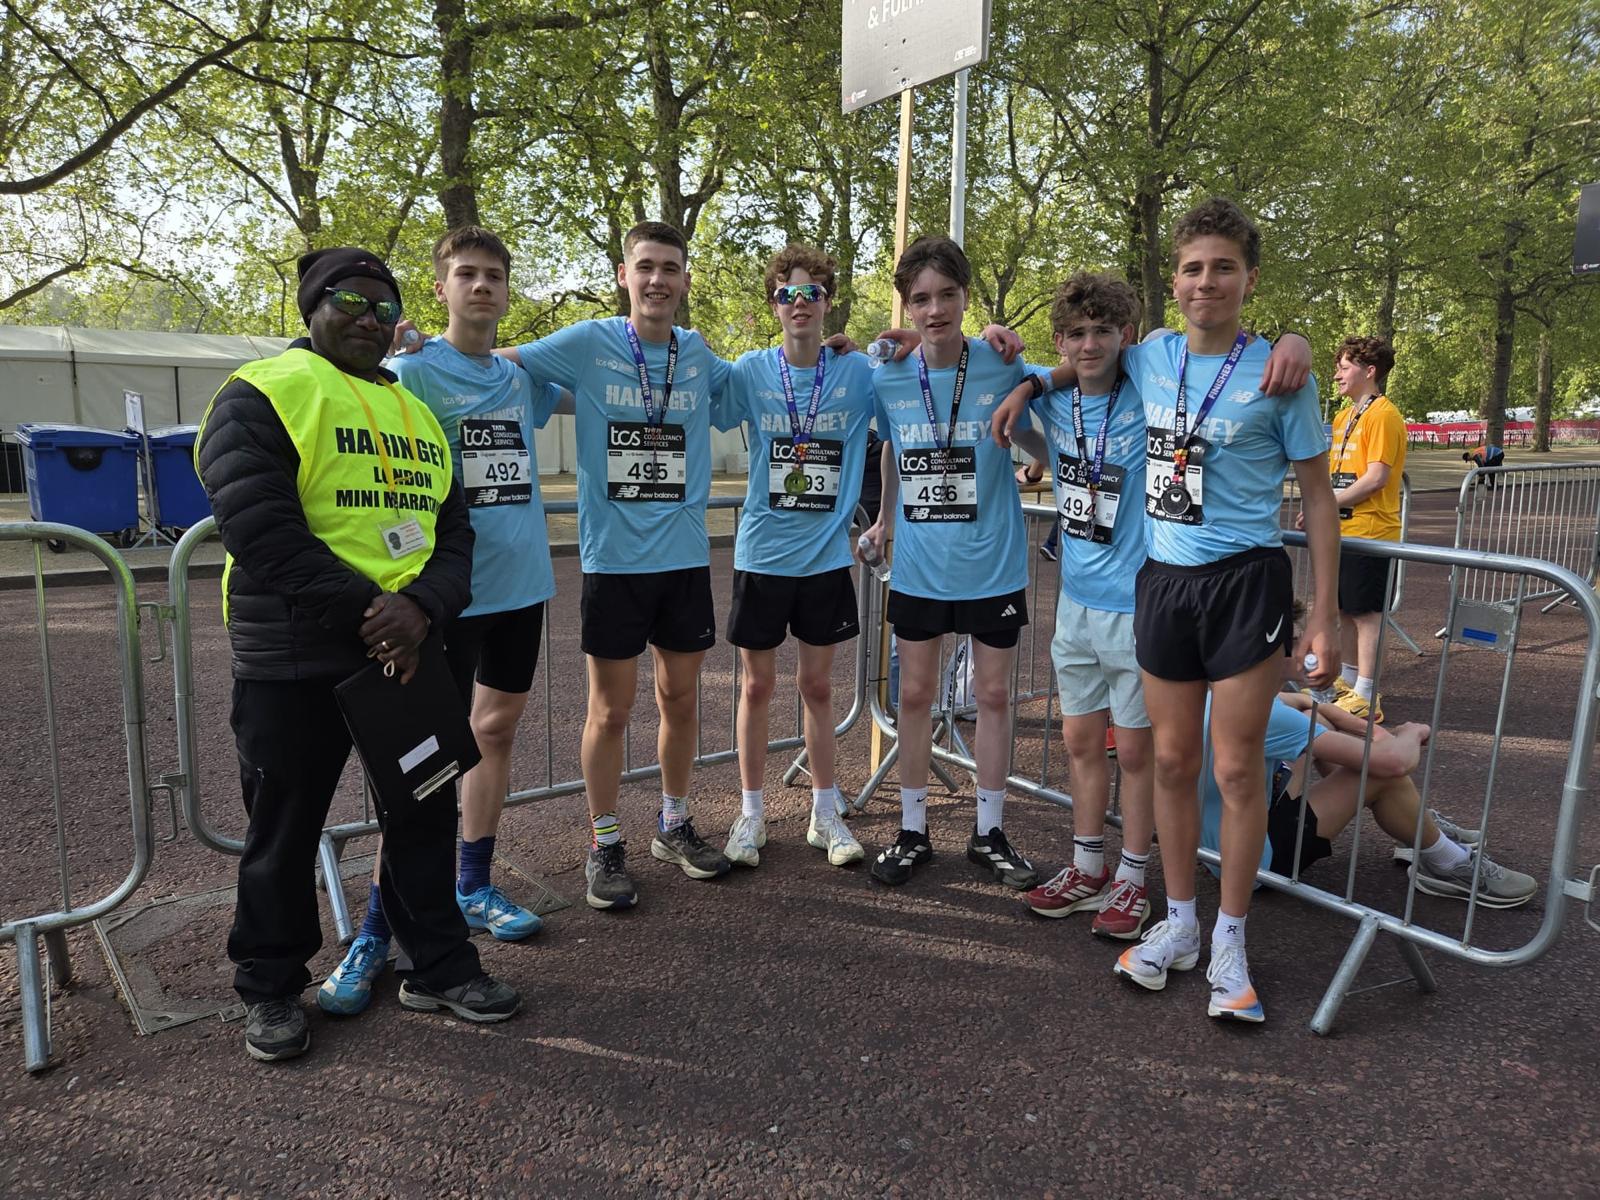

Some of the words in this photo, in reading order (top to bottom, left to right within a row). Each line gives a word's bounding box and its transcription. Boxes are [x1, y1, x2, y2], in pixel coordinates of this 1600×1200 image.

[867, 5, 879, 29] &
[959, 350, 968, 369] 2026
[1207, 363, 1234, 400] FINISHER
[1228, 343, 1244, 363] 2026
[953, 371, 966, 404] FINISHER
[809, 385, 821, 416] FINISHER
[803, 416, 814, 435] 2026
[1072, 405, 1084, 438] FINISHER
[1175, 416, 1186, 437] 2026
[463, 425, 492, 447] tcs
[610, 425, 641, 447] tcs
[806, 449, 841, 457] ONSULTANCY
[901, 453, 928, 472] tcs
[485, 462, 521, 483] 492
[627, 462, 668, 481] 495
[335, 489, 381, 508] MINI
[653, 491, 680, 500] balance
[917, 484, 958, 503] 496
[943, 512, 970, 520] balance
[1068, 527, 1080, 535] new
